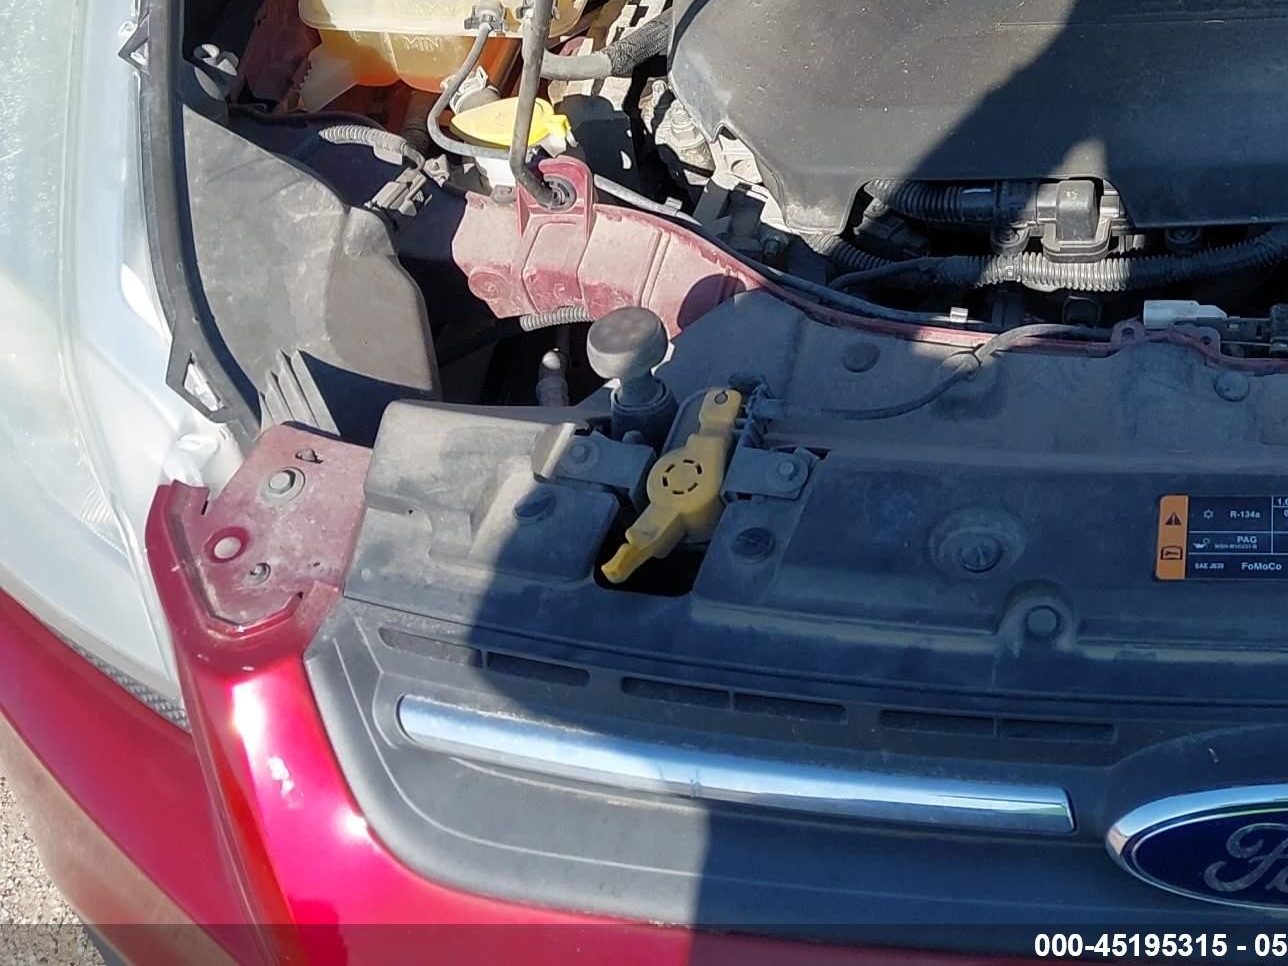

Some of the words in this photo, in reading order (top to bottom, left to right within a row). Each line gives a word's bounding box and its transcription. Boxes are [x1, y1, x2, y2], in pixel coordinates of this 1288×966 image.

[401, 35, 442, 51] MIN
[1230, 510, 1260, 518] R-134a
[1241, 562, 1282, 570] FoMoCo
